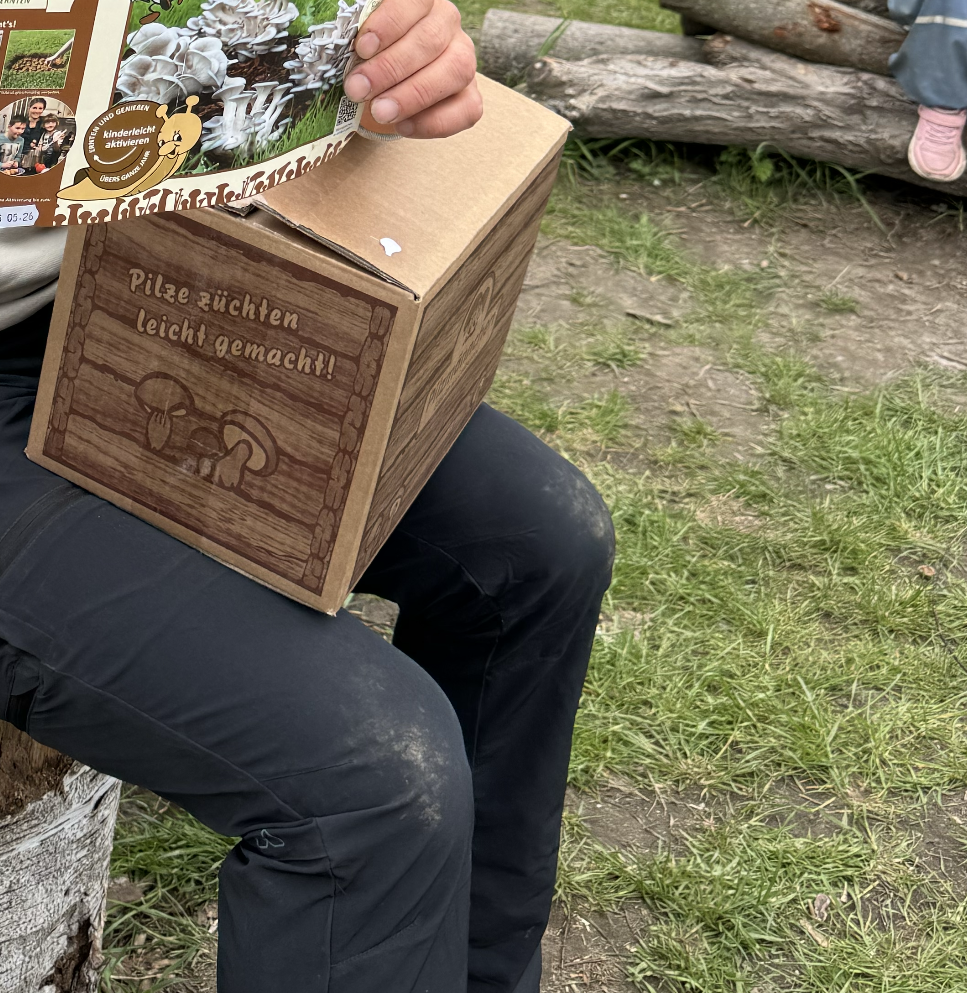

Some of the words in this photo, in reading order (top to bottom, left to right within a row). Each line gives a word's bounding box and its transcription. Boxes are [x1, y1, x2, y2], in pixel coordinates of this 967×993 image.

[98, 112, 114, 126] UND
[102, 125, 156, 139] kinderleicht
[104, 137, 150, 149] aktivieren
[99, 174, 120, 183] ÜBERS
[120, 165, 141, 181] GANZE
[139, 150, 151, 167] JAHR
[128, 267, 191, 305] Pilze
[196, 288, 300, 330] züchten
[136, 308, 207, 348] leicht
[214, 334, 337, 380] gemacht!
